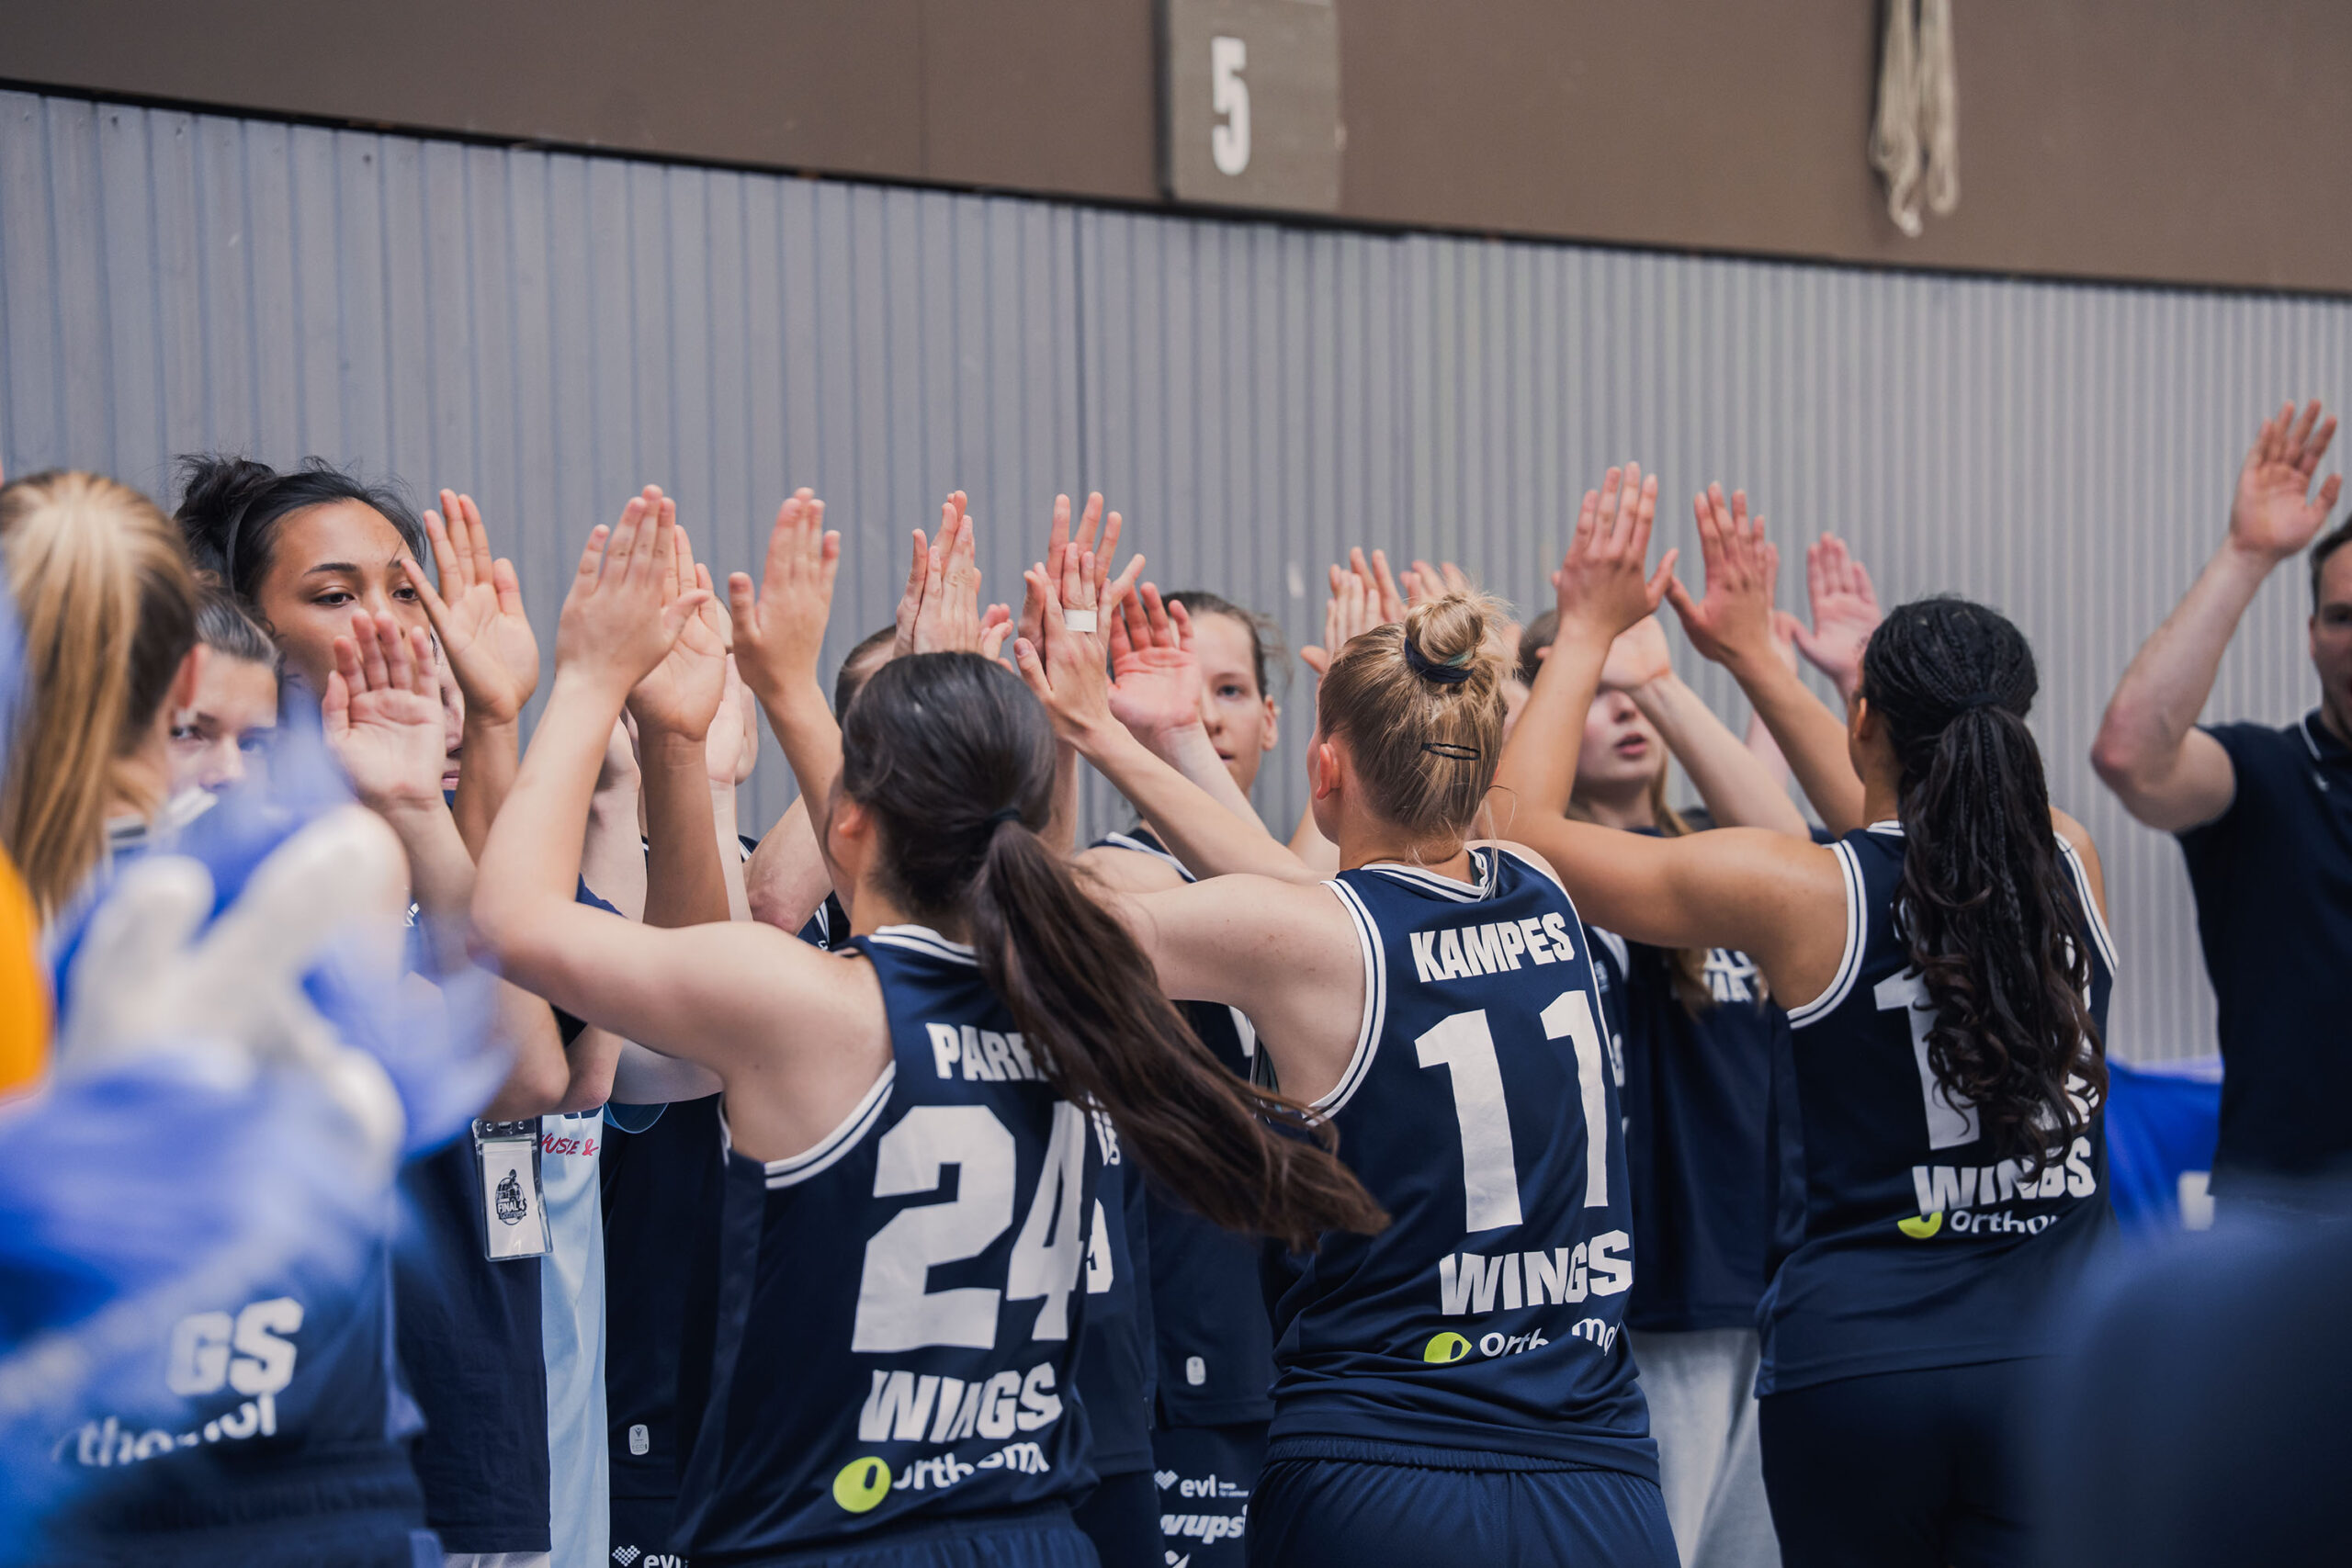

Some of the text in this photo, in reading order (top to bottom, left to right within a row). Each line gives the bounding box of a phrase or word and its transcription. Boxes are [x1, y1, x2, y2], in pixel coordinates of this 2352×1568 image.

[1212, 35, 1251, 176] 5
[1409, 912, 1575, 983] KAMPES
[1414, 990, 1614, 1233] 11
[851, 1100, 1086, 1353] 24
[1951, 1210, 2059, 1235] Ortho
[1439, 1229, 1633, 1315] WINGS
[166, 1296, 304, 1396] GS
[858, 1361, 1064, 1443] WINGS
[1180, 1473, 1216, 1497] evl
